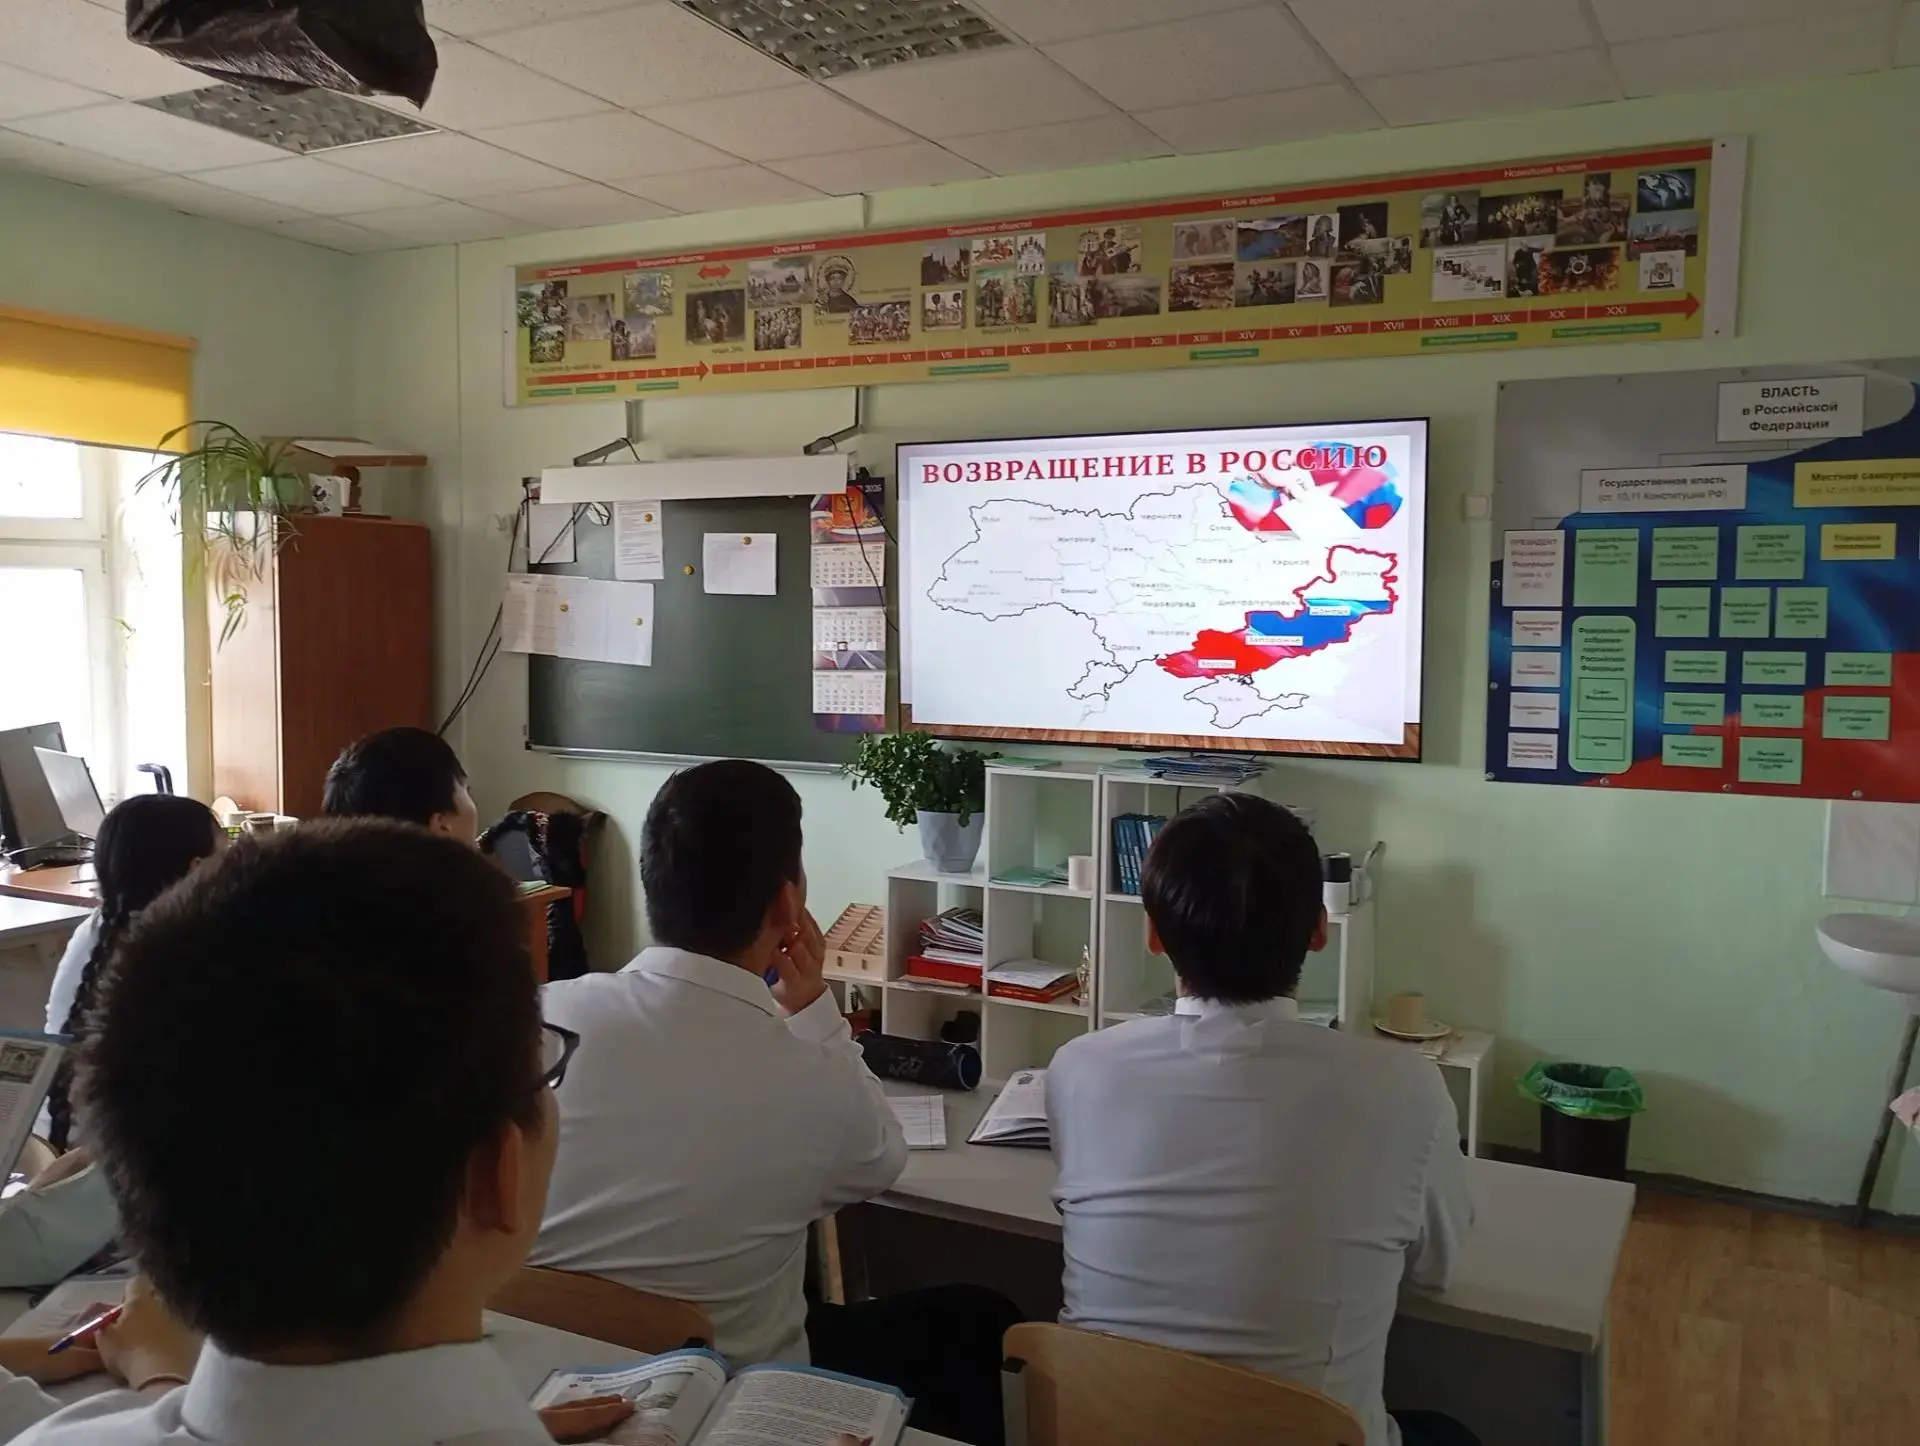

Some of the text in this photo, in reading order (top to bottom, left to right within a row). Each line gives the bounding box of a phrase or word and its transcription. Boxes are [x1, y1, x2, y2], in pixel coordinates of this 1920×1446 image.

[1761, 385, 1820, 399] ВЛАСТЬ
[1742, 402, 1838, 416] в Российской
[1749, 420, 1830, 432] Федерации
[922, 445, 1388, 484] ВОЗВРАЩЕНИЕ В РОССИЮ
[1599, 478, 1687, 489] Государственная
